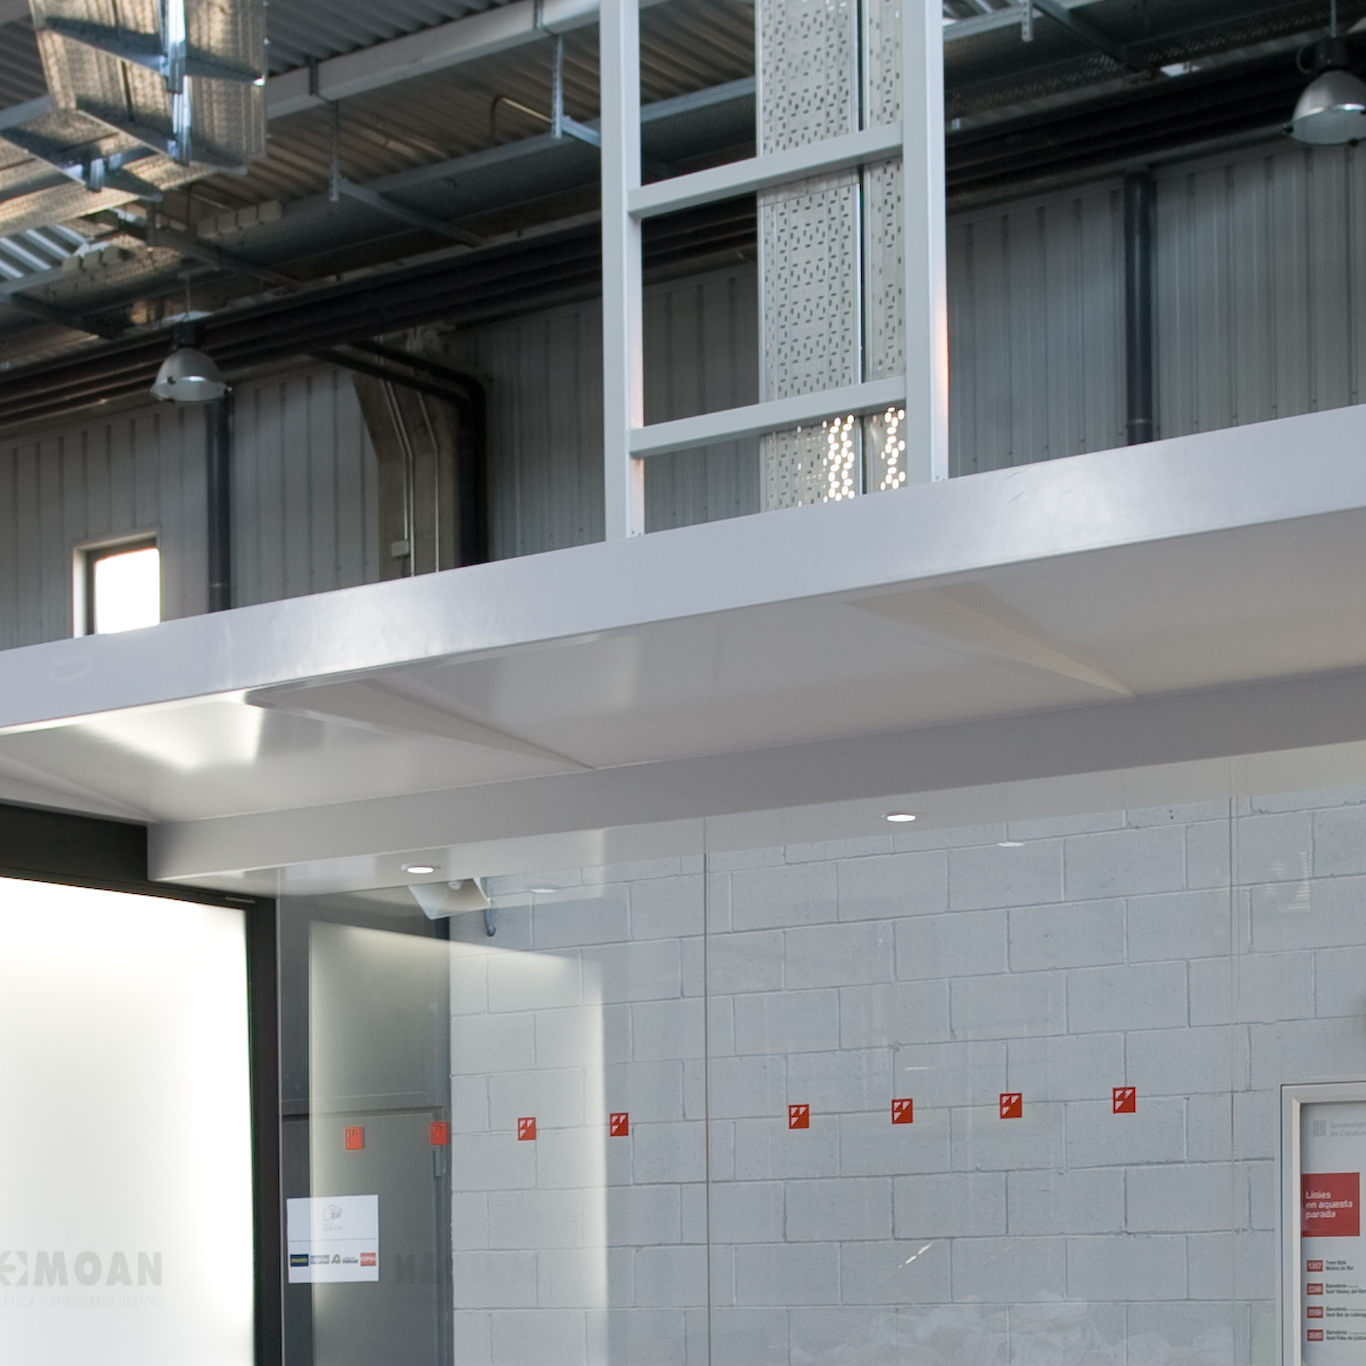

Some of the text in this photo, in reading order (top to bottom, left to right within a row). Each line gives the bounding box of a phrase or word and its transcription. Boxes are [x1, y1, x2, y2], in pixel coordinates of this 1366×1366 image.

[1329, 1120, 1366, 1130] Generalitat
[1305, 1200, 1354, 1210] en aquesta
[1305, 1210, 1337, 1220] parada
